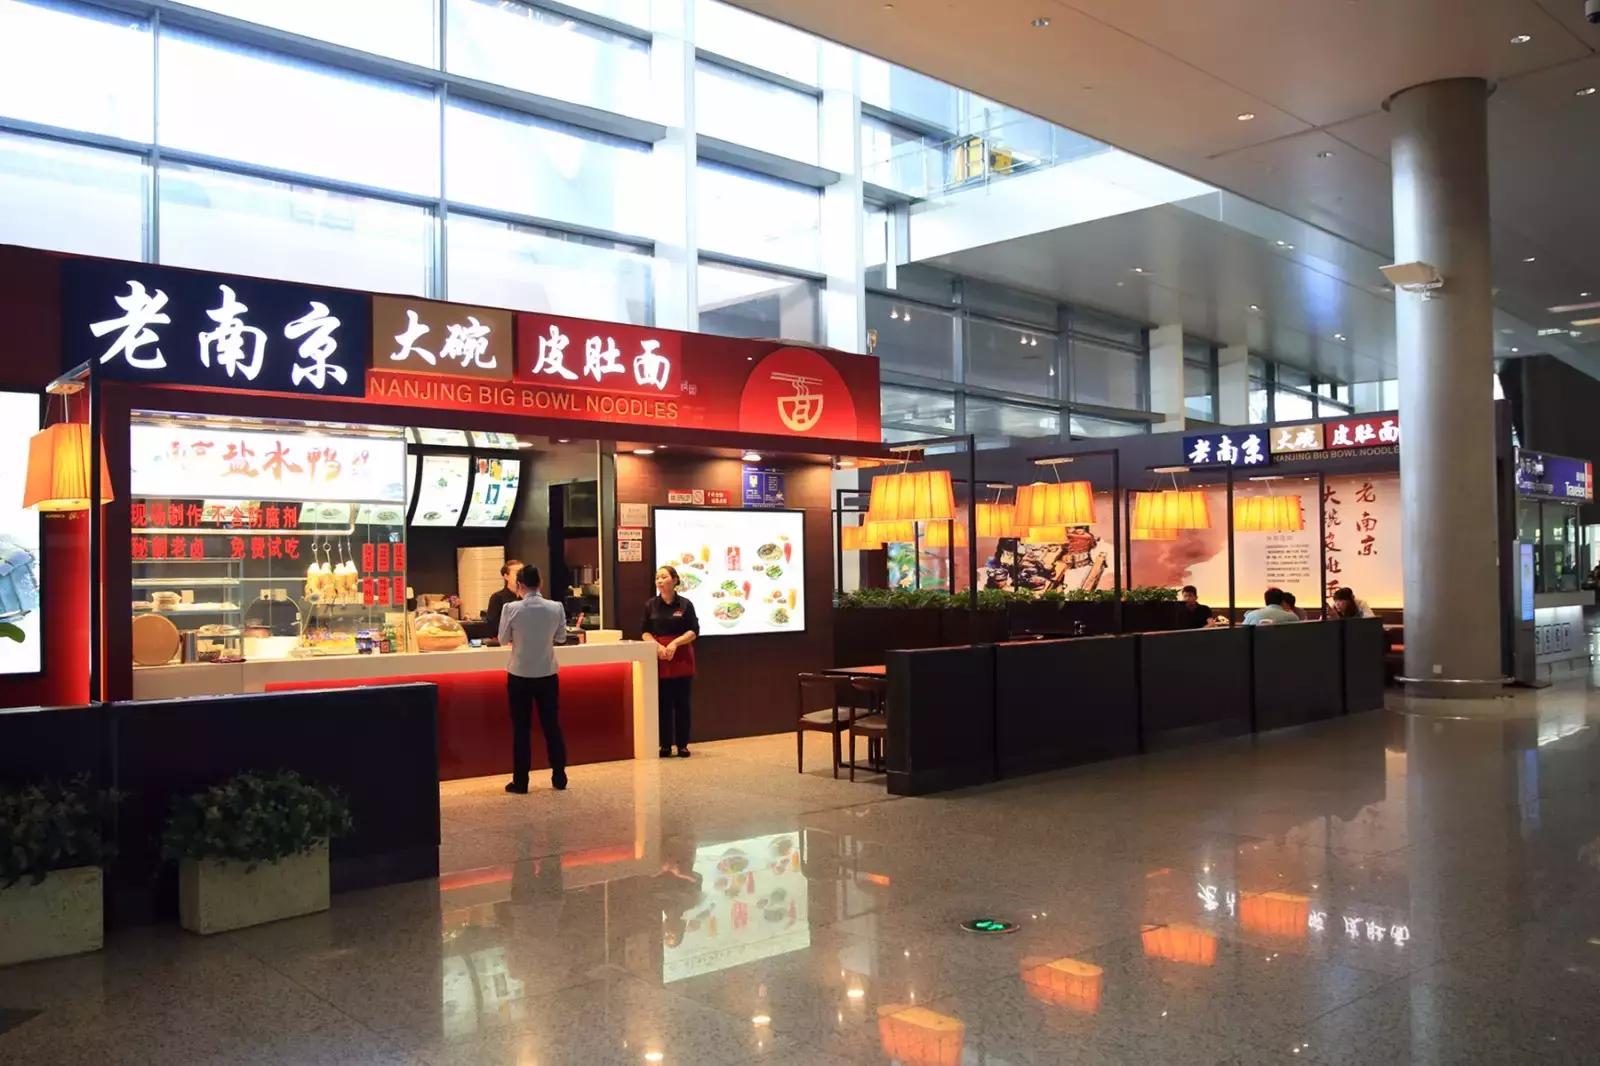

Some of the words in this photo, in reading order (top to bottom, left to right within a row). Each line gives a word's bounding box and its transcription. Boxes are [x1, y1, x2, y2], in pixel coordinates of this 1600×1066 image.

[89, 280, 348, 389] 老南京
[390, 309, 497, 369] 大碗
[531, 325, 672, 391] 皮肚面
[370, 376, 472, 403] NANJING
[479, 386, 515, 407] BIG
[522, 391, 581, 412] BOWL
[586, 394, 679, 421] NOODLES
[1188, 434, 1264, 464] 老南京
[1276, 427, 1318, 450] 大碗
[1332, 420, 1400, 446] 皮肚面
[1273, 452, 1311, 463] NANJING
[1313, 451, 1329, 460] BIG
[1331, 449, 1358, 459] BOWL
[1359, 446, 1400, 457] NOODLE
[132, 503, 203, 527] 现场制作
[1356, 482, 1378, 556] 老南京
[230, 536, 300, 560] 免费试吃
